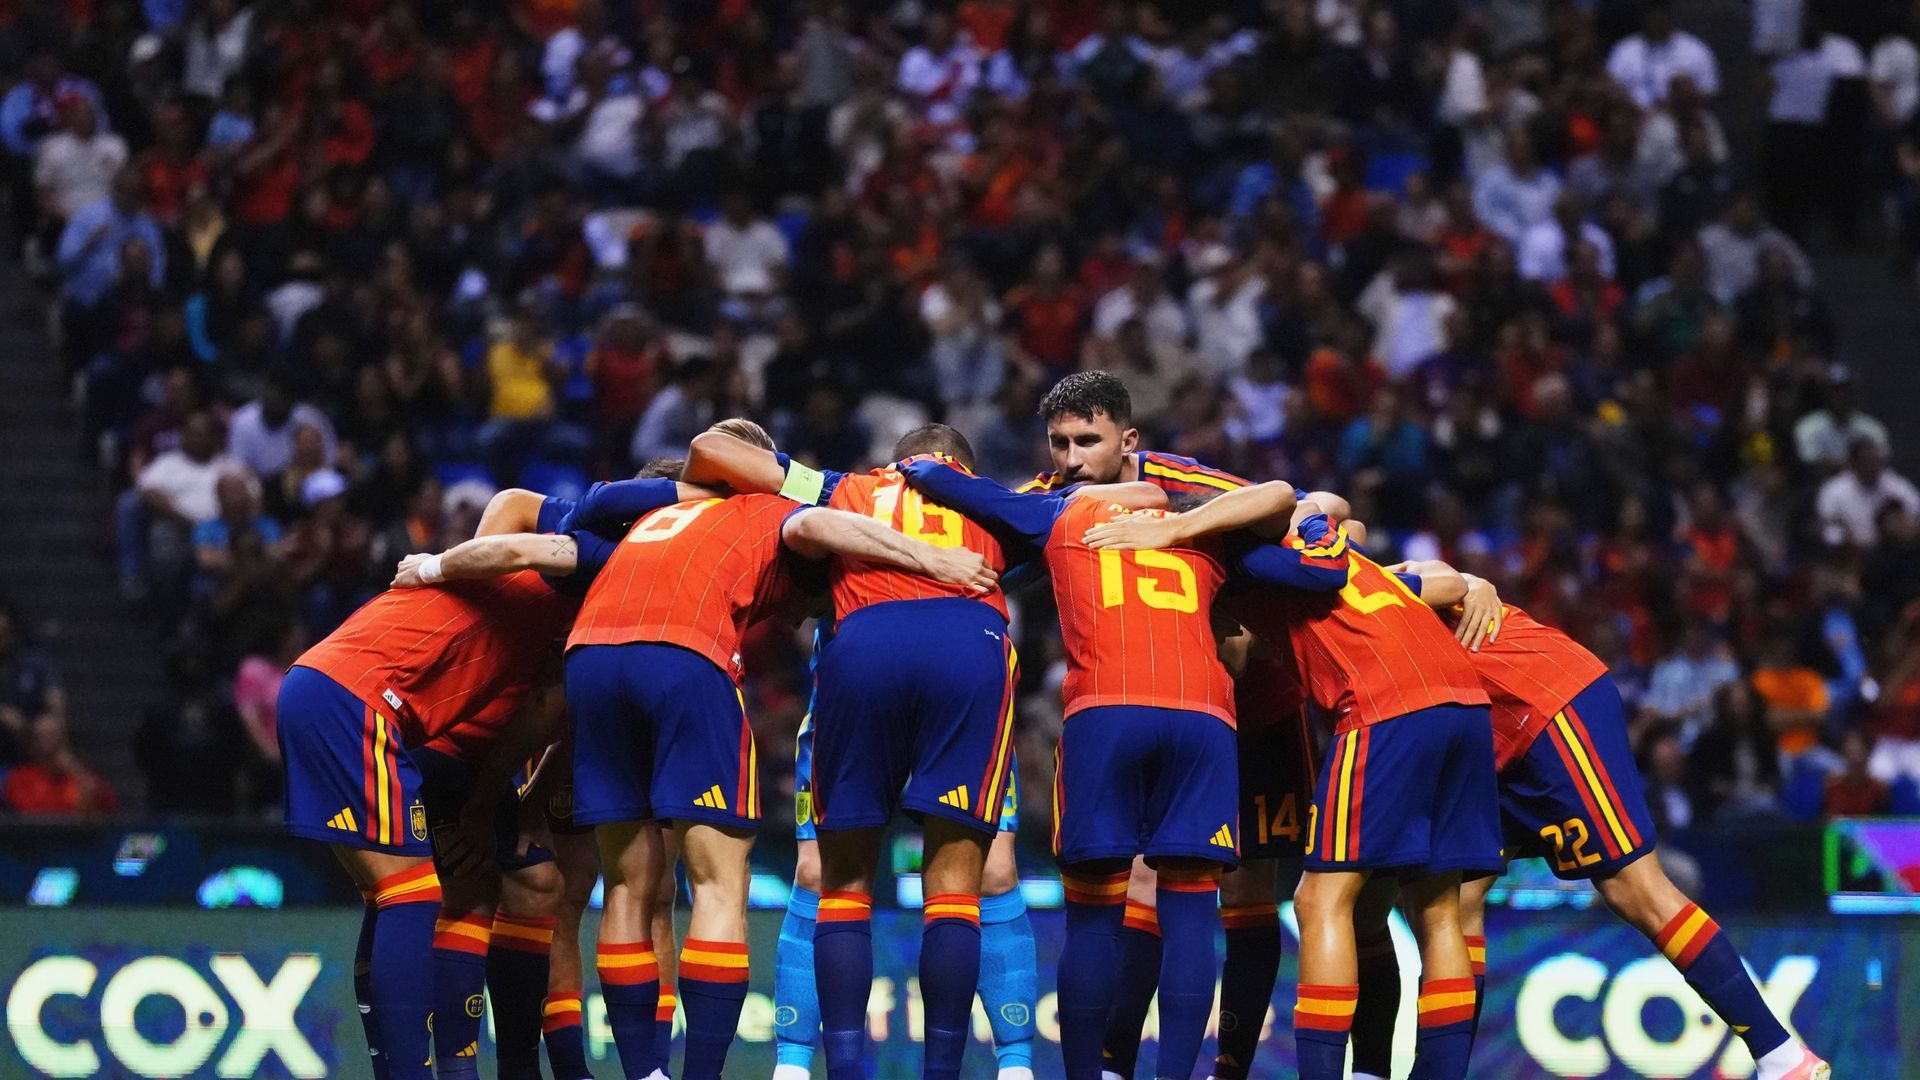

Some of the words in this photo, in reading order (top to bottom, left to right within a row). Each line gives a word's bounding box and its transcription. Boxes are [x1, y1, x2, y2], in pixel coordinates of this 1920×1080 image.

[627, 498, 726, 543] 8
[871, 483, 963, 549] 16
[1094, 521, 1199, 614] 15
[1253, 792, 1300, 844] 14
[1540, 818, 1602, 871] 22
[7, 954, 326, 1079] COX
